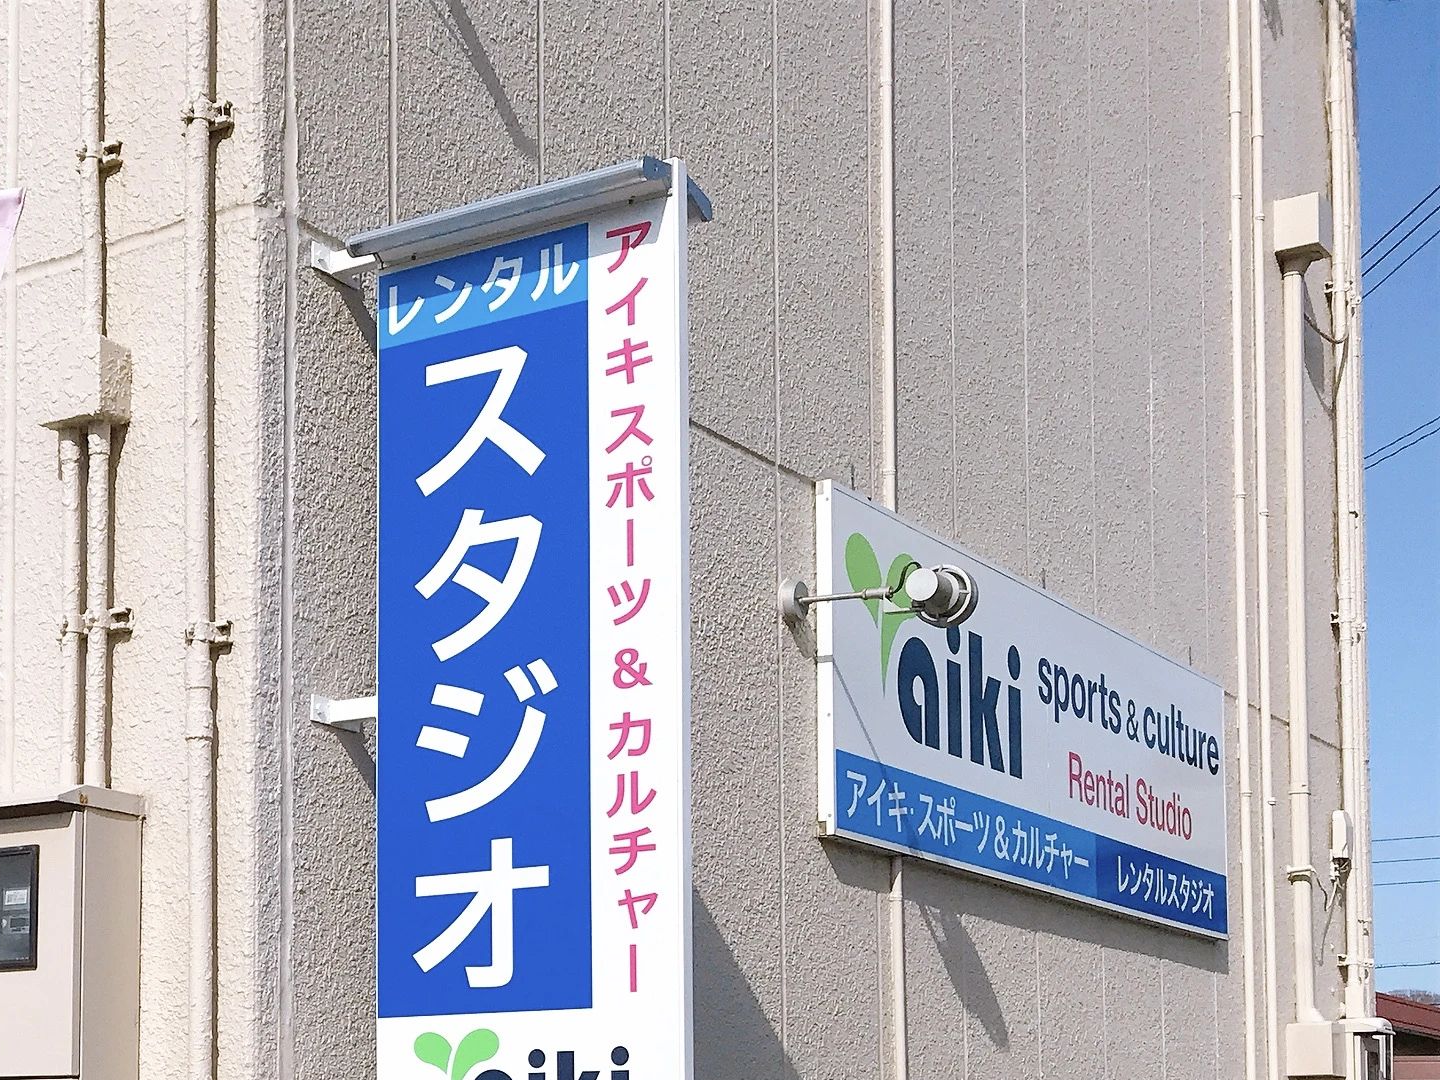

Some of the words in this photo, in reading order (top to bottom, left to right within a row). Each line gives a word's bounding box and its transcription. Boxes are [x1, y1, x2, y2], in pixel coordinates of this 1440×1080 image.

[387, 243, 580, 336] レンタル
[412, 345, 559, 988] スタジオ
[898, 624, 1023, 780] aiki
[1038, 657, 1122, 735] sports
[1126, 699, 1140, 742] &
[1143, 704, 1220, 776] culture
[1068, 751, 1130, 818] Rental
[1136, 777, 1193, 840] Studio
[1116, 854, 1215, 919] レンタルスタジオ
